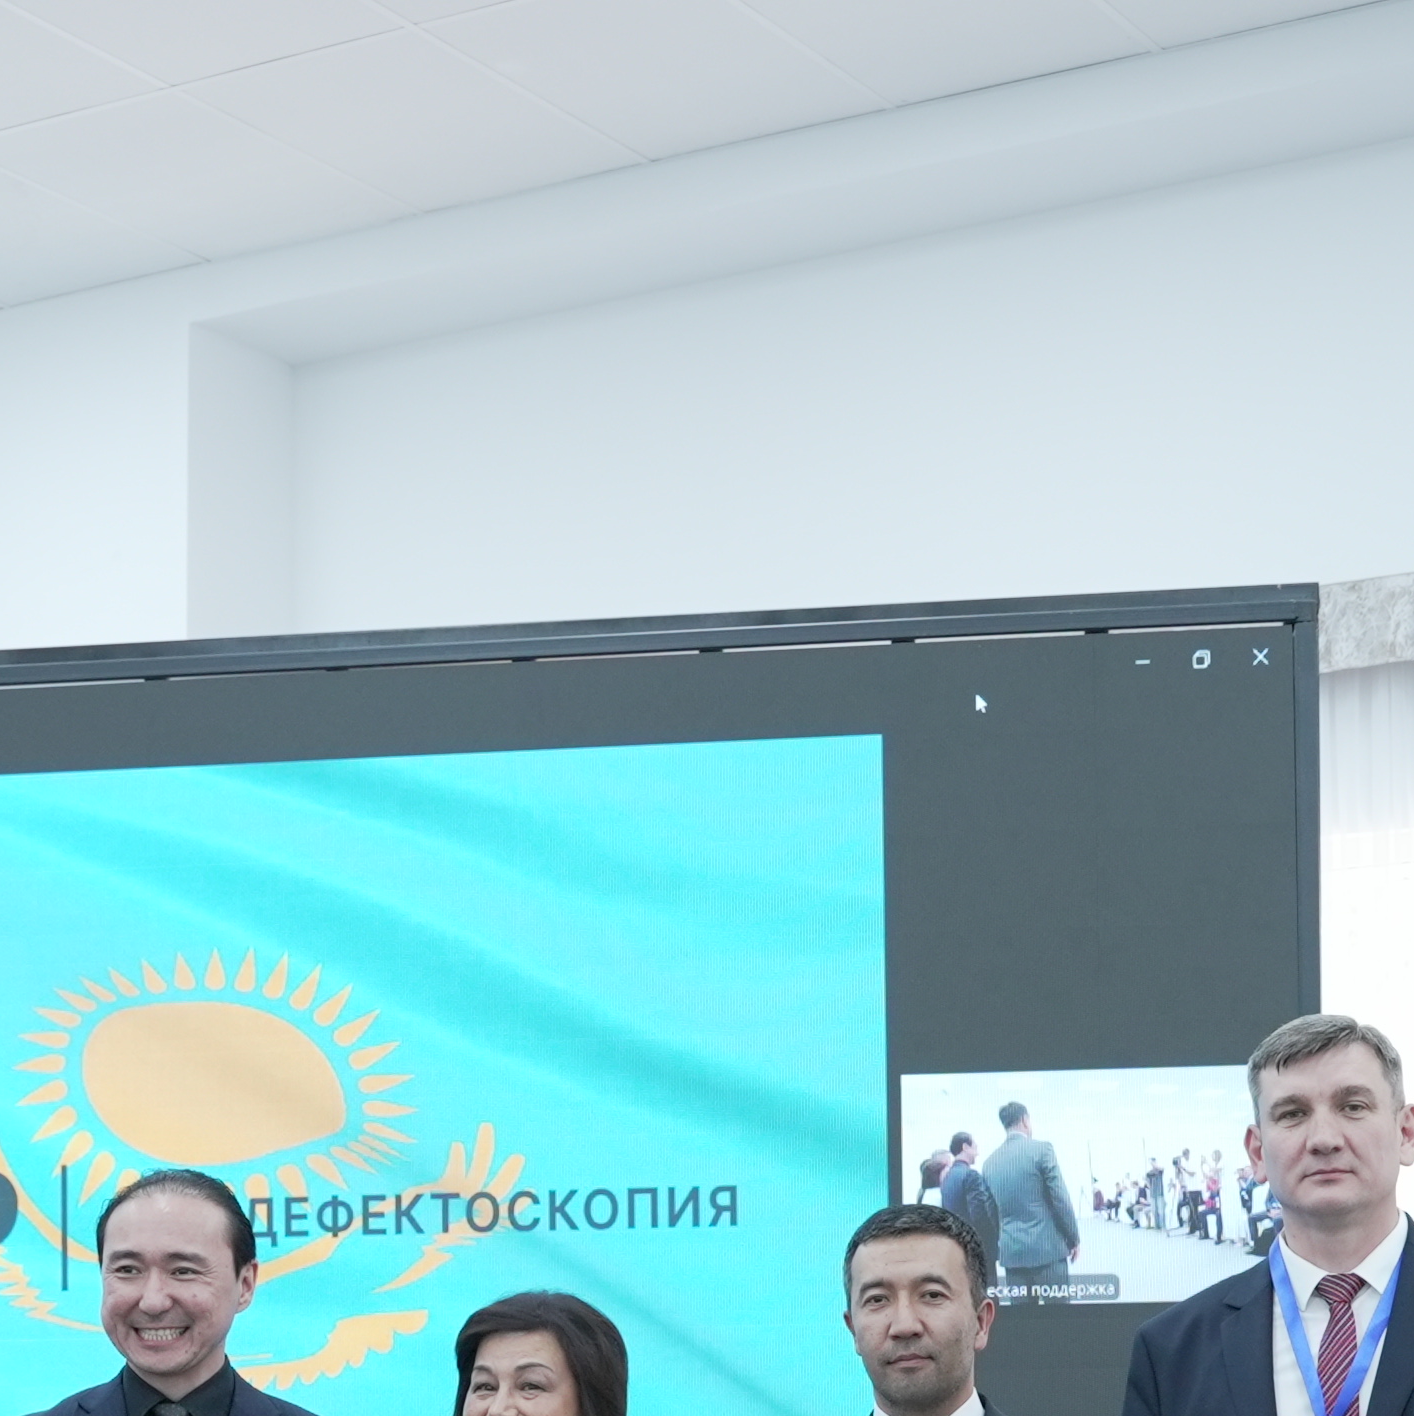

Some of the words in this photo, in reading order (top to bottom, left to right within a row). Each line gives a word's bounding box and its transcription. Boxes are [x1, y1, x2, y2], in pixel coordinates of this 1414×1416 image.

[250, 1184, 739, 1248] ДЕФЕКТОСКОПИЯ
[986, 1285, 1028, 1298] еская
[1031, 1282, 1116, 1300] поддержка
